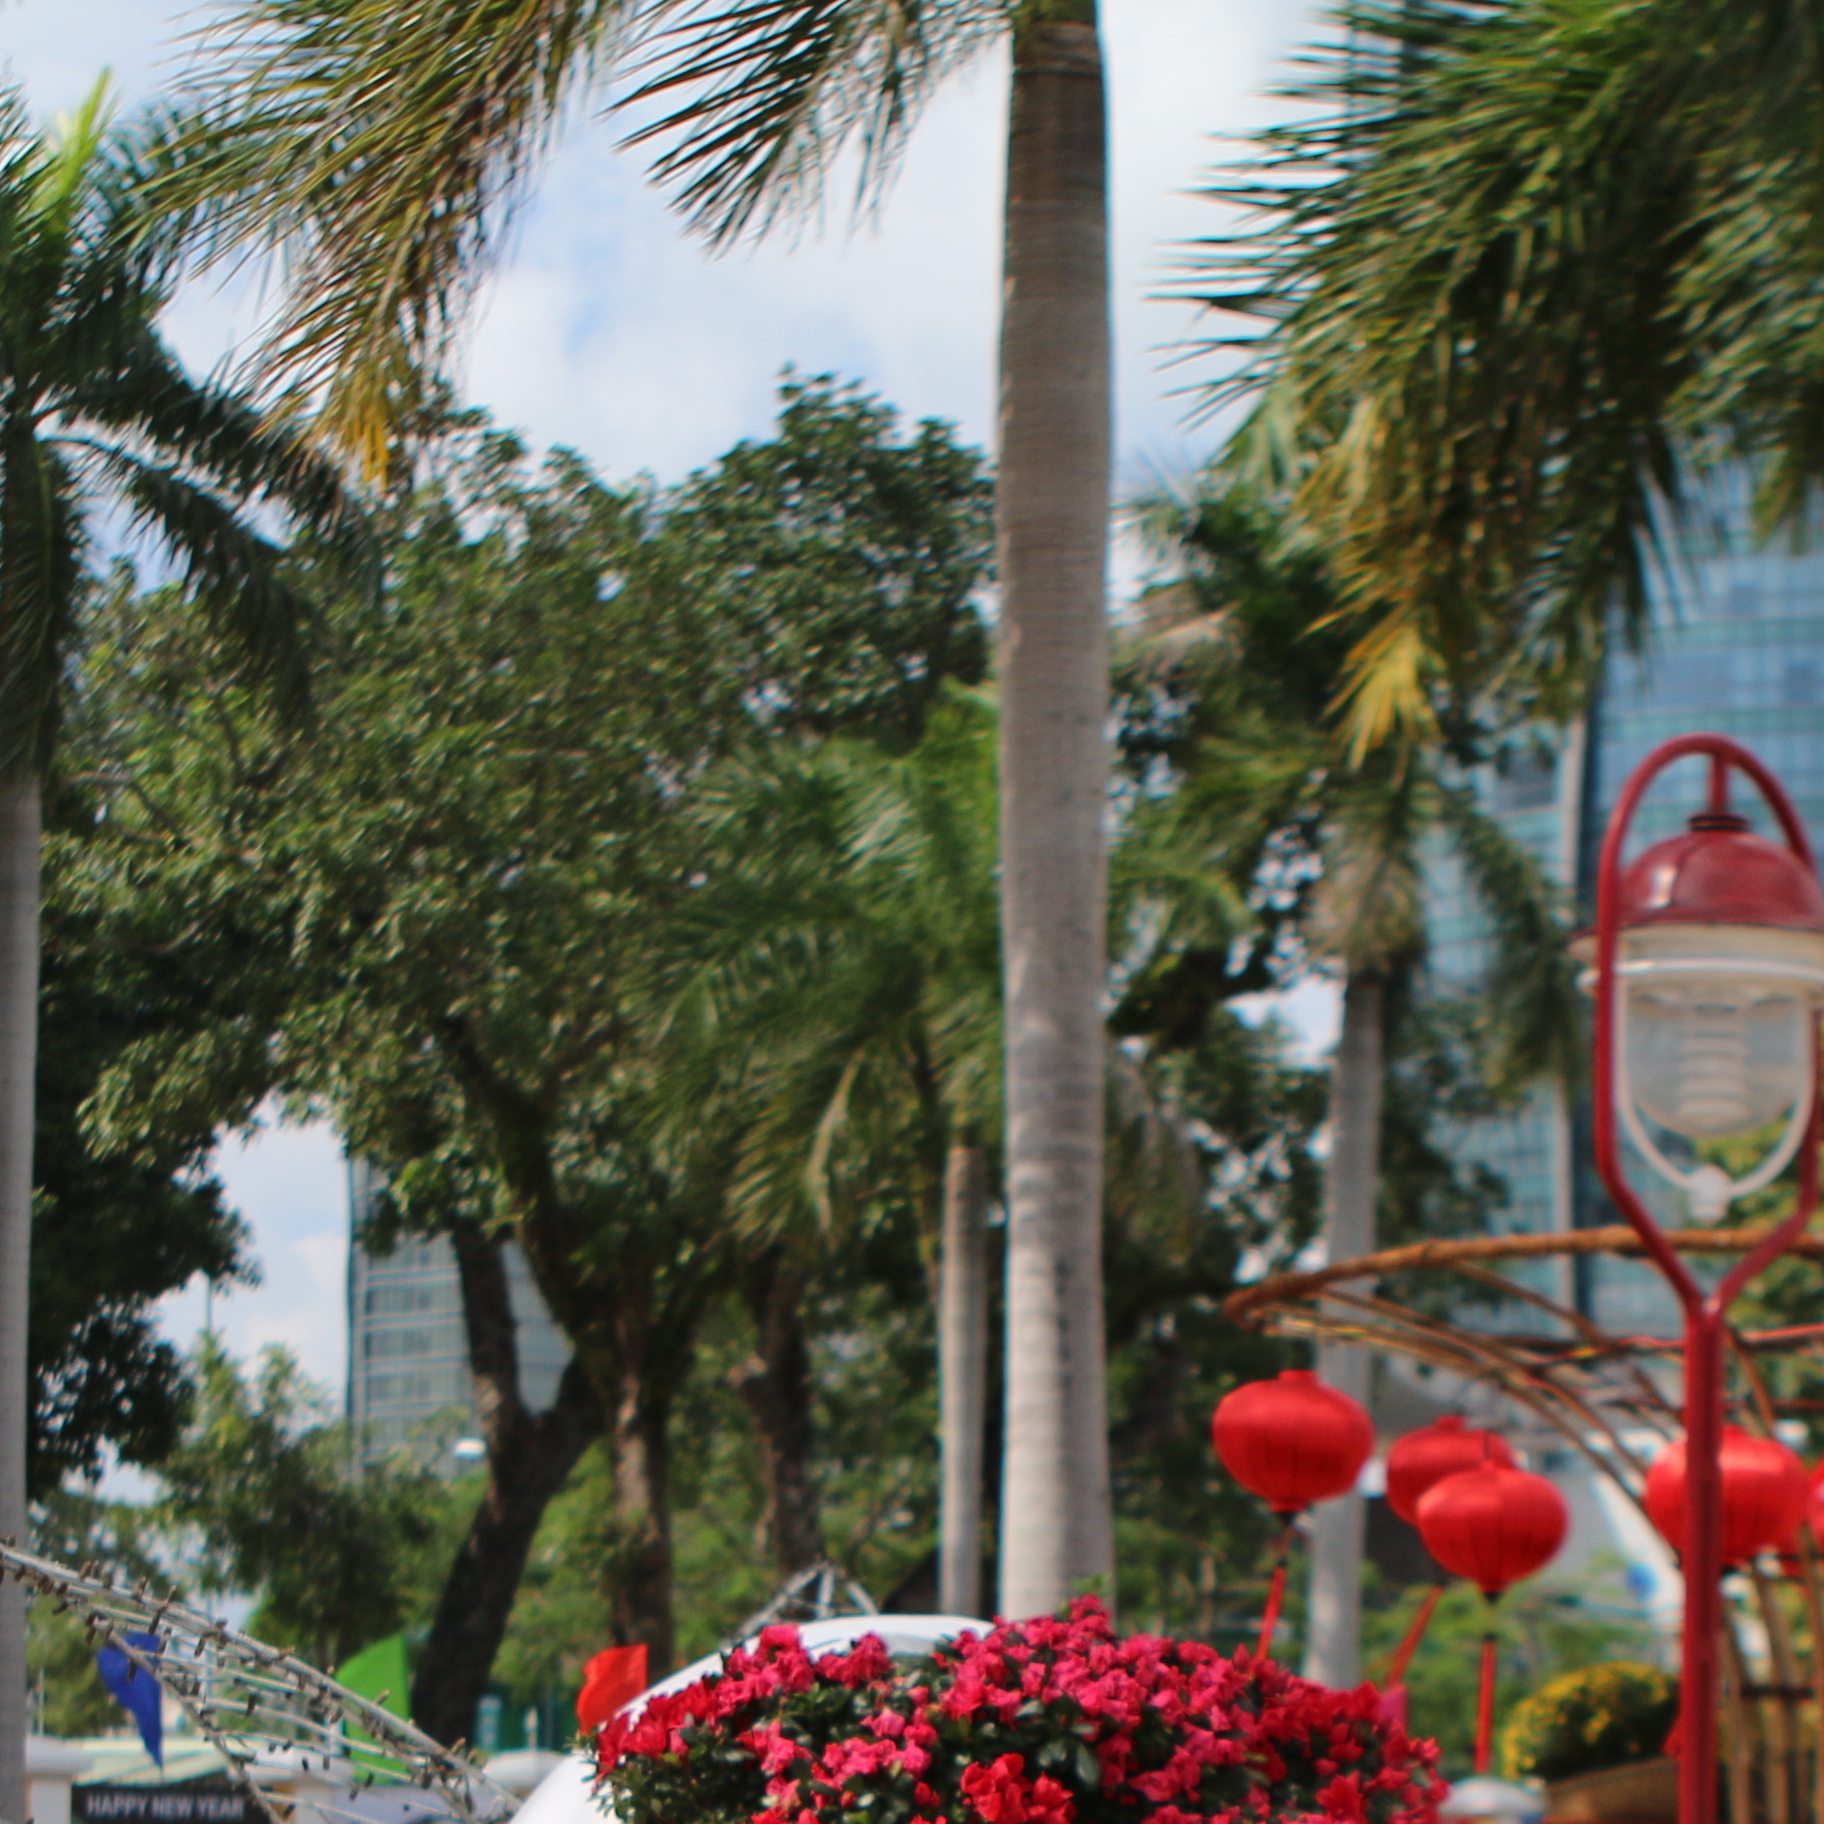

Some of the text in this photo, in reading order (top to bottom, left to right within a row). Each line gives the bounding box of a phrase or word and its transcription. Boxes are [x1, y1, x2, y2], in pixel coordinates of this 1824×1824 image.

[87, 1793, 244, 1821] HAPPY NEW YEAR
